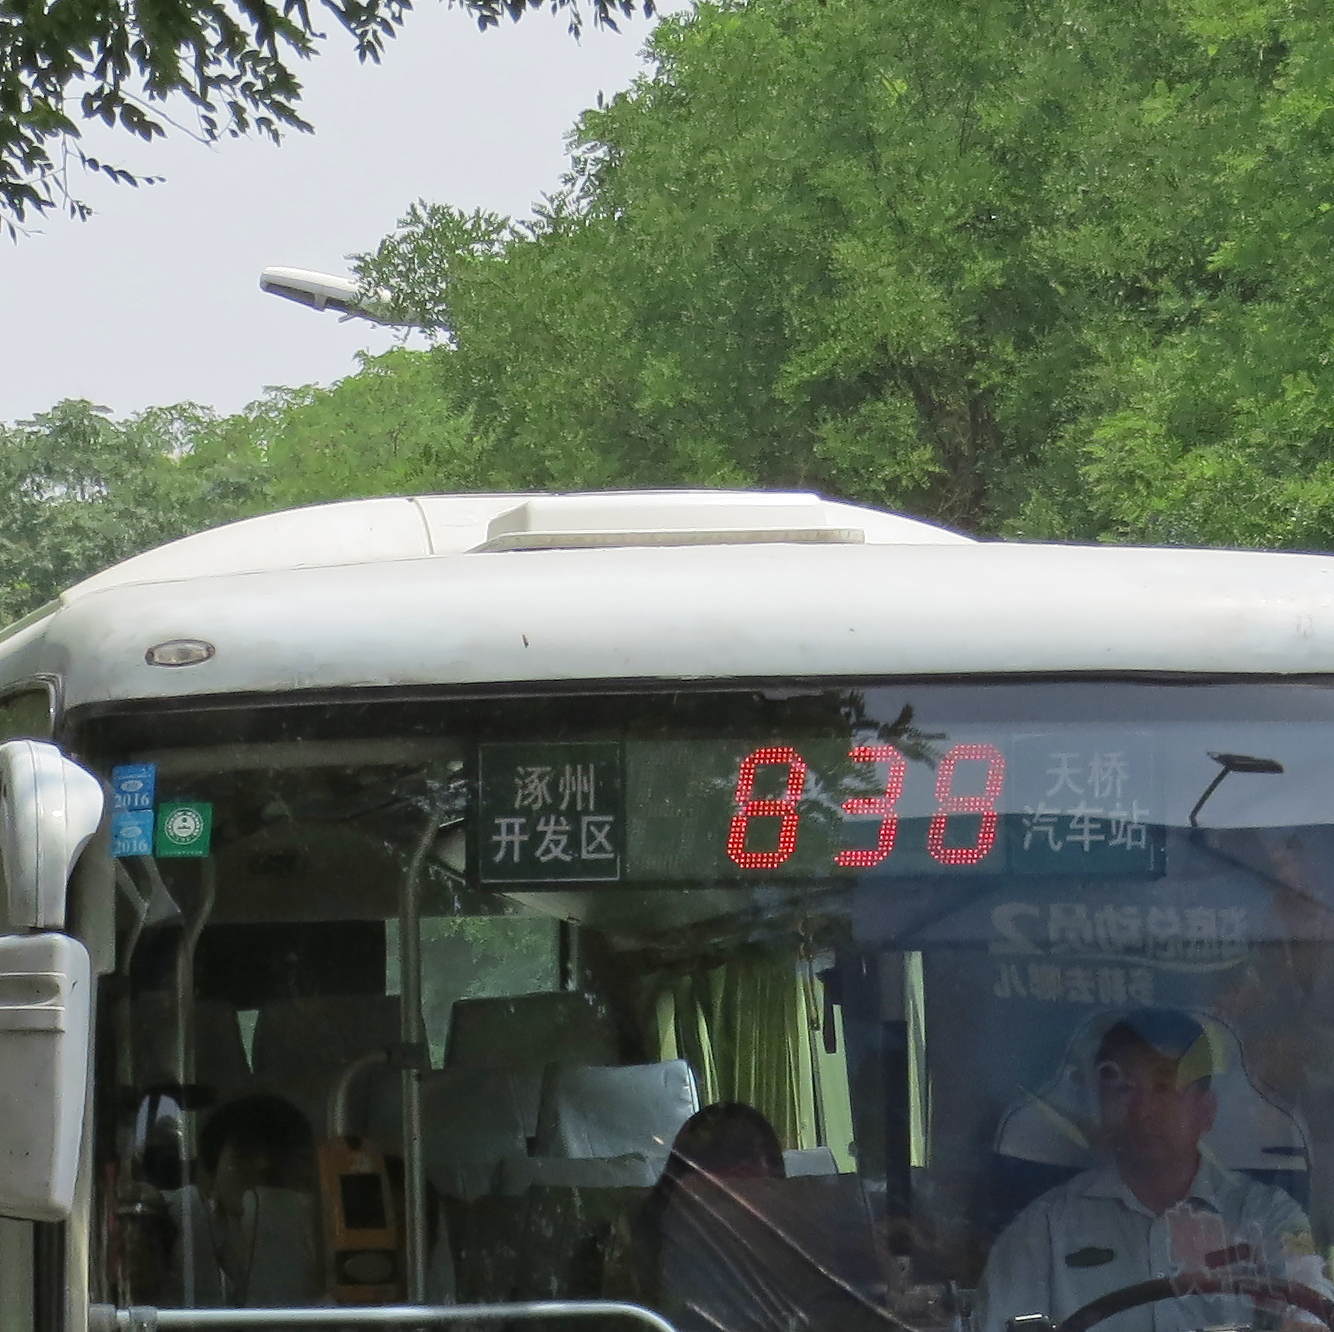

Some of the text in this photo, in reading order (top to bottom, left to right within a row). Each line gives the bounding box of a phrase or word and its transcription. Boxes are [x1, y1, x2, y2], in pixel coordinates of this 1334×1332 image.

[514, 763, 595, 811] 涿州
[1045, 750, 1129, 799] 天桥
[114, 793, 150, 809] 2016
[726, 743, 1007, 868] 838
[113, 839, 148, 855] 2016
[491, 814, 615, 864] 开发区
[1020, 801, 1151, 852] 汽车站
